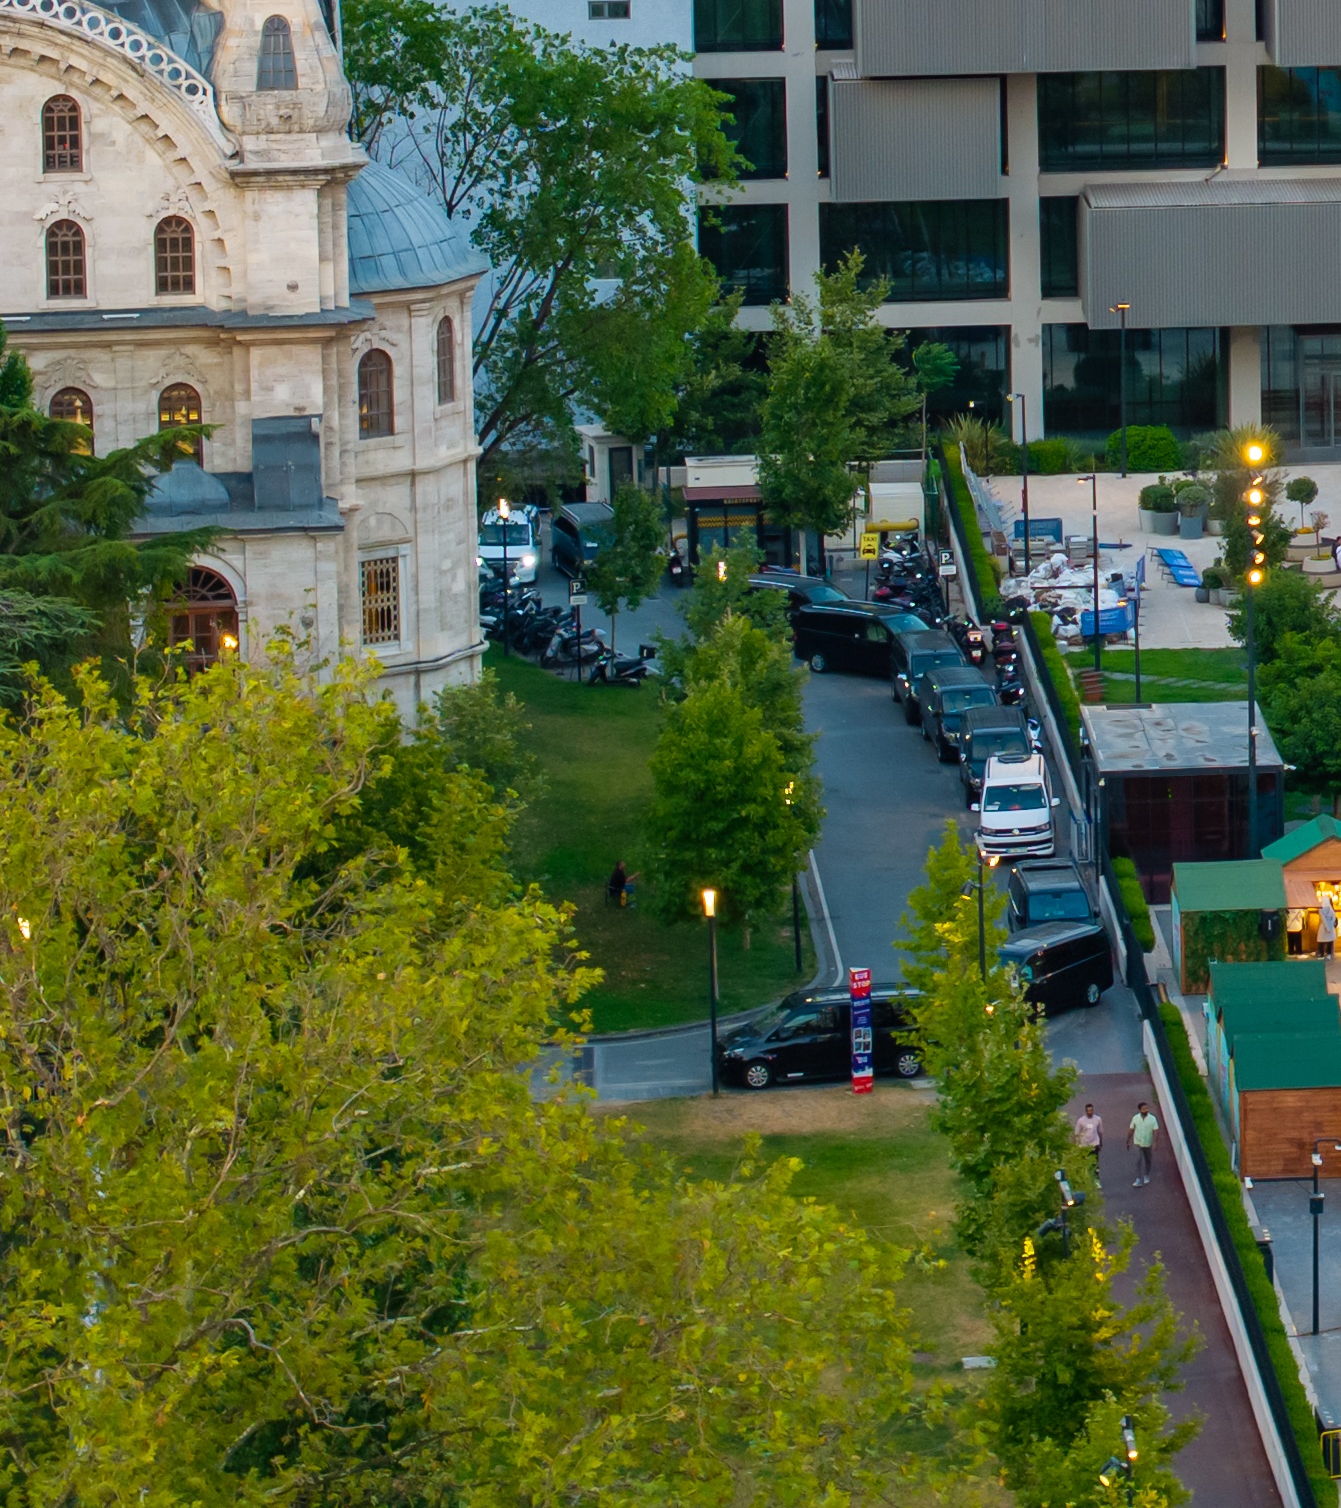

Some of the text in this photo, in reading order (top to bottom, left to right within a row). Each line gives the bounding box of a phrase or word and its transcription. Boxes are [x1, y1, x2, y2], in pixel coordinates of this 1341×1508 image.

[941, 553, 951, 563] P
[572, 582, 581, 593] P
[852, 980, 871, 989] STOP
